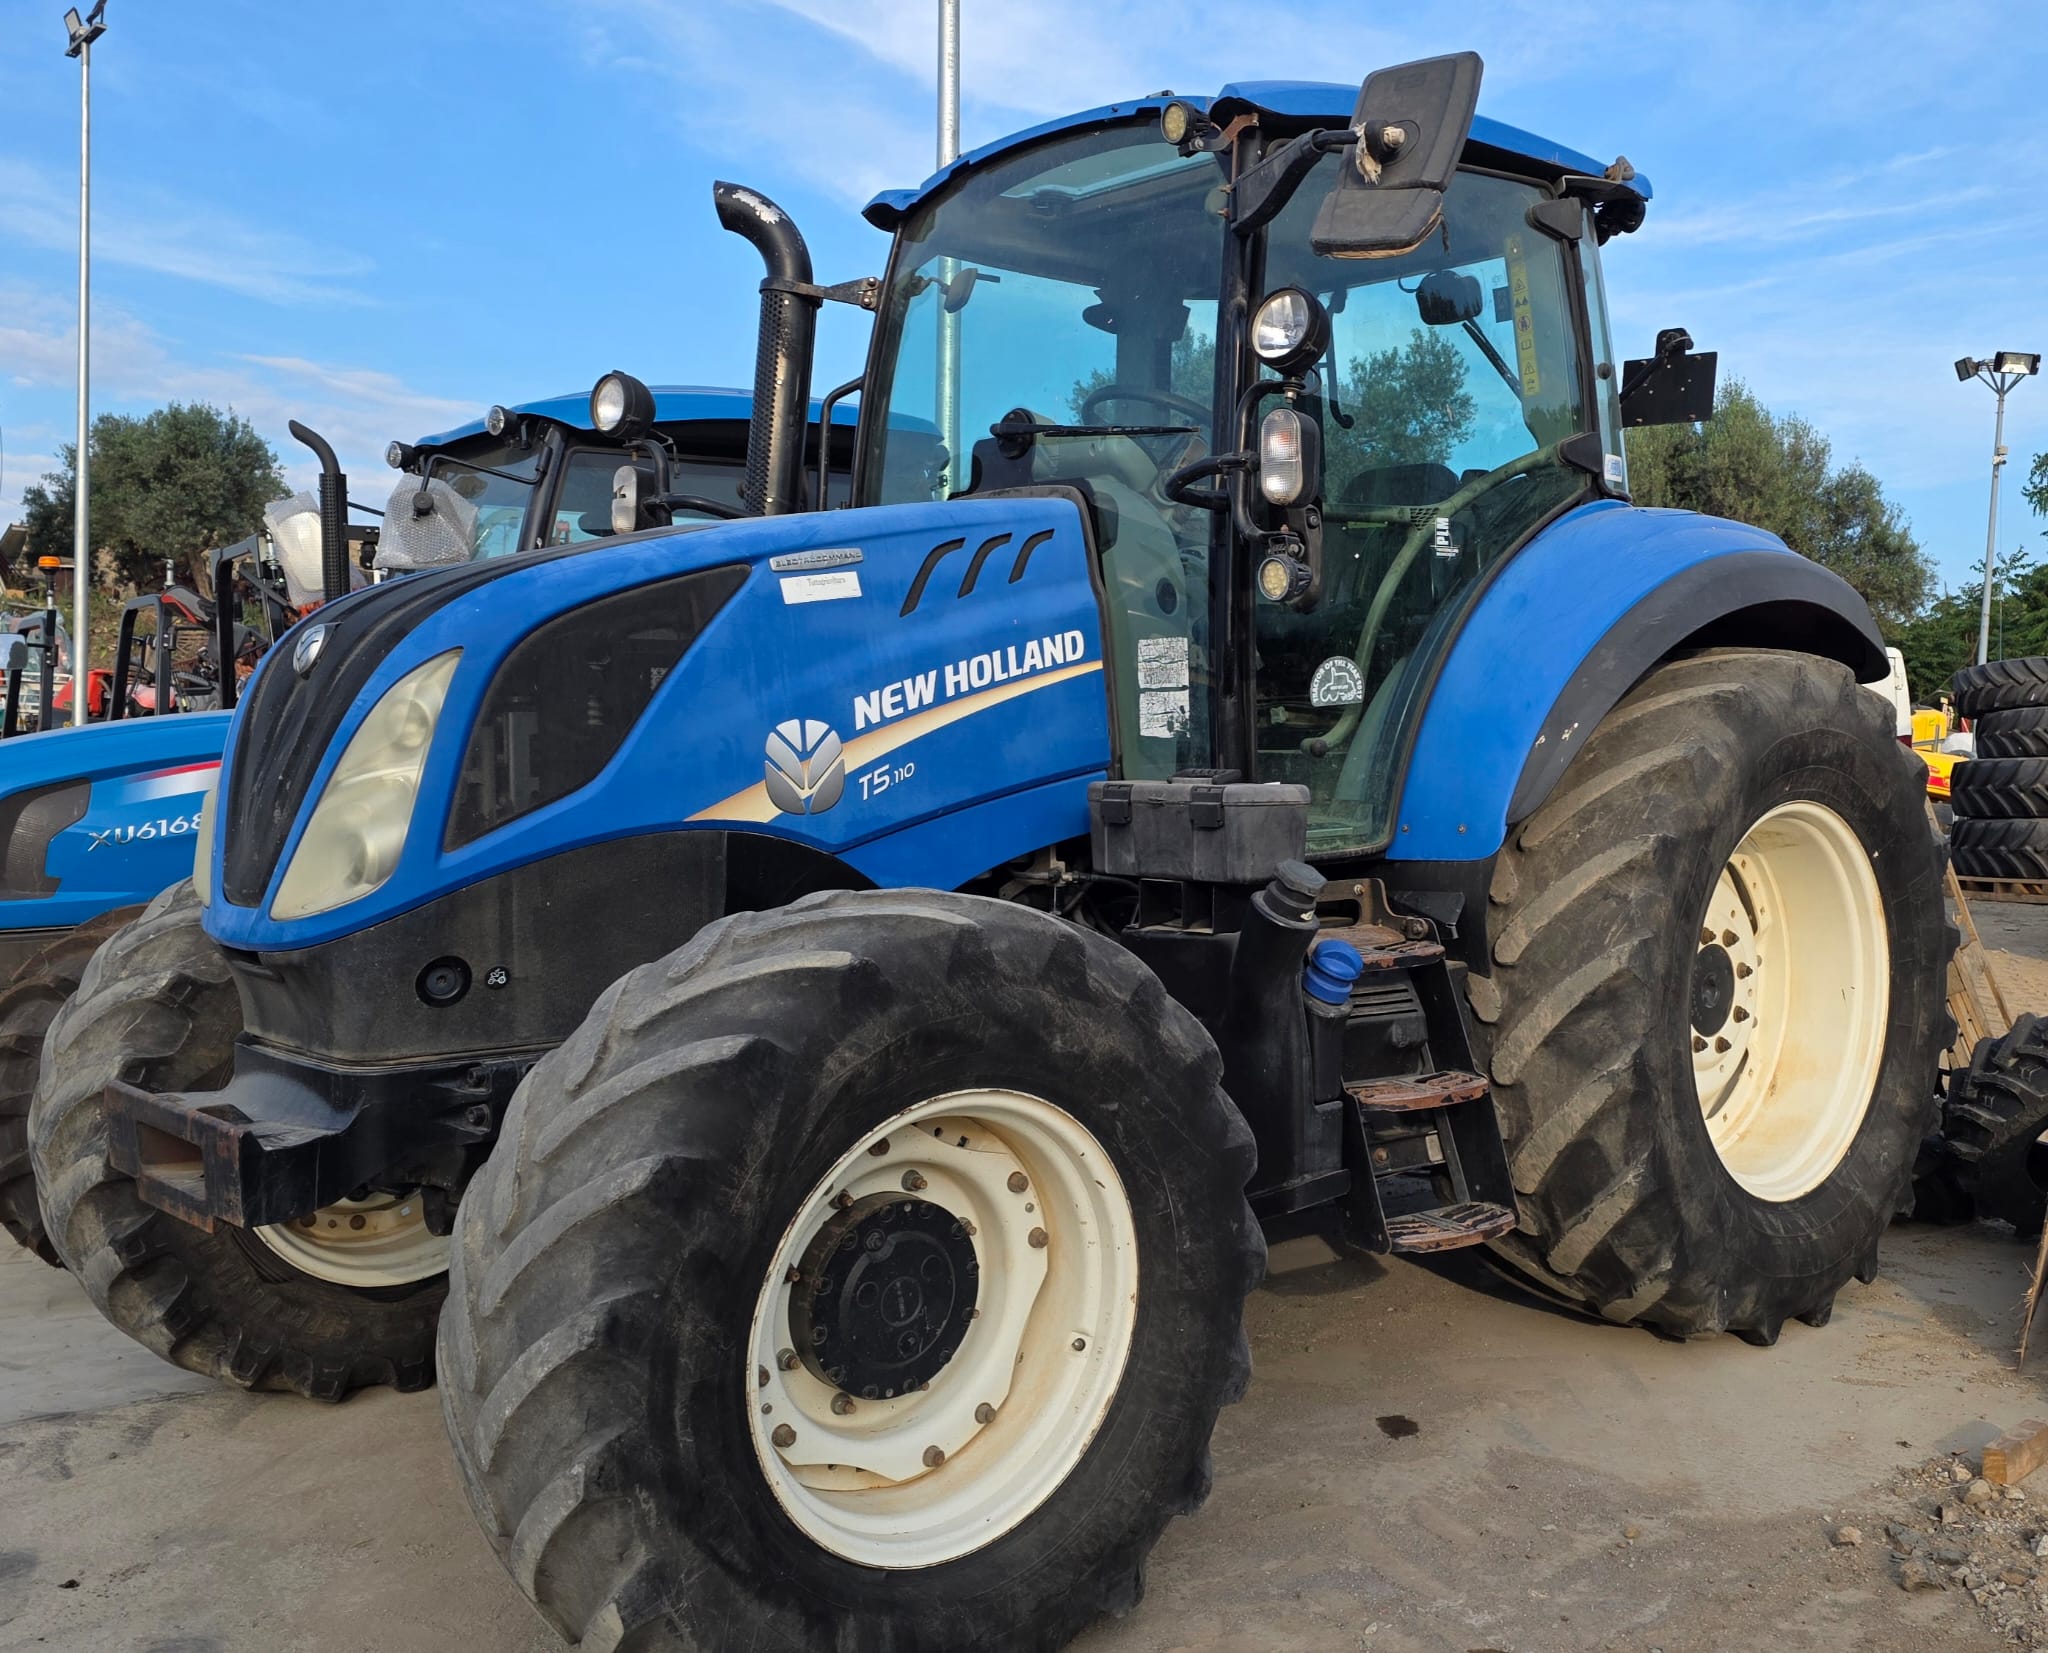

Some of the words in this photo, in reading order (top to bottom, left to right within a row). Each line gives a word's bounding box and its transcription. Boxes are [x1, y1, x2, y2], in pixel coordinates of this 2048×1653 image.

[853, 669, 937, 731] NEW
[944, 629, 1085, 698] HOLLAND
[1312, 668, 1326, 703] TRACTOR
[1324, 660, 1334, 670] OF
[1334, 659, 1347, 667] THE
[1346, 662, 1361, 680] YEAR
[858, 762, 916, 801] T5.110
